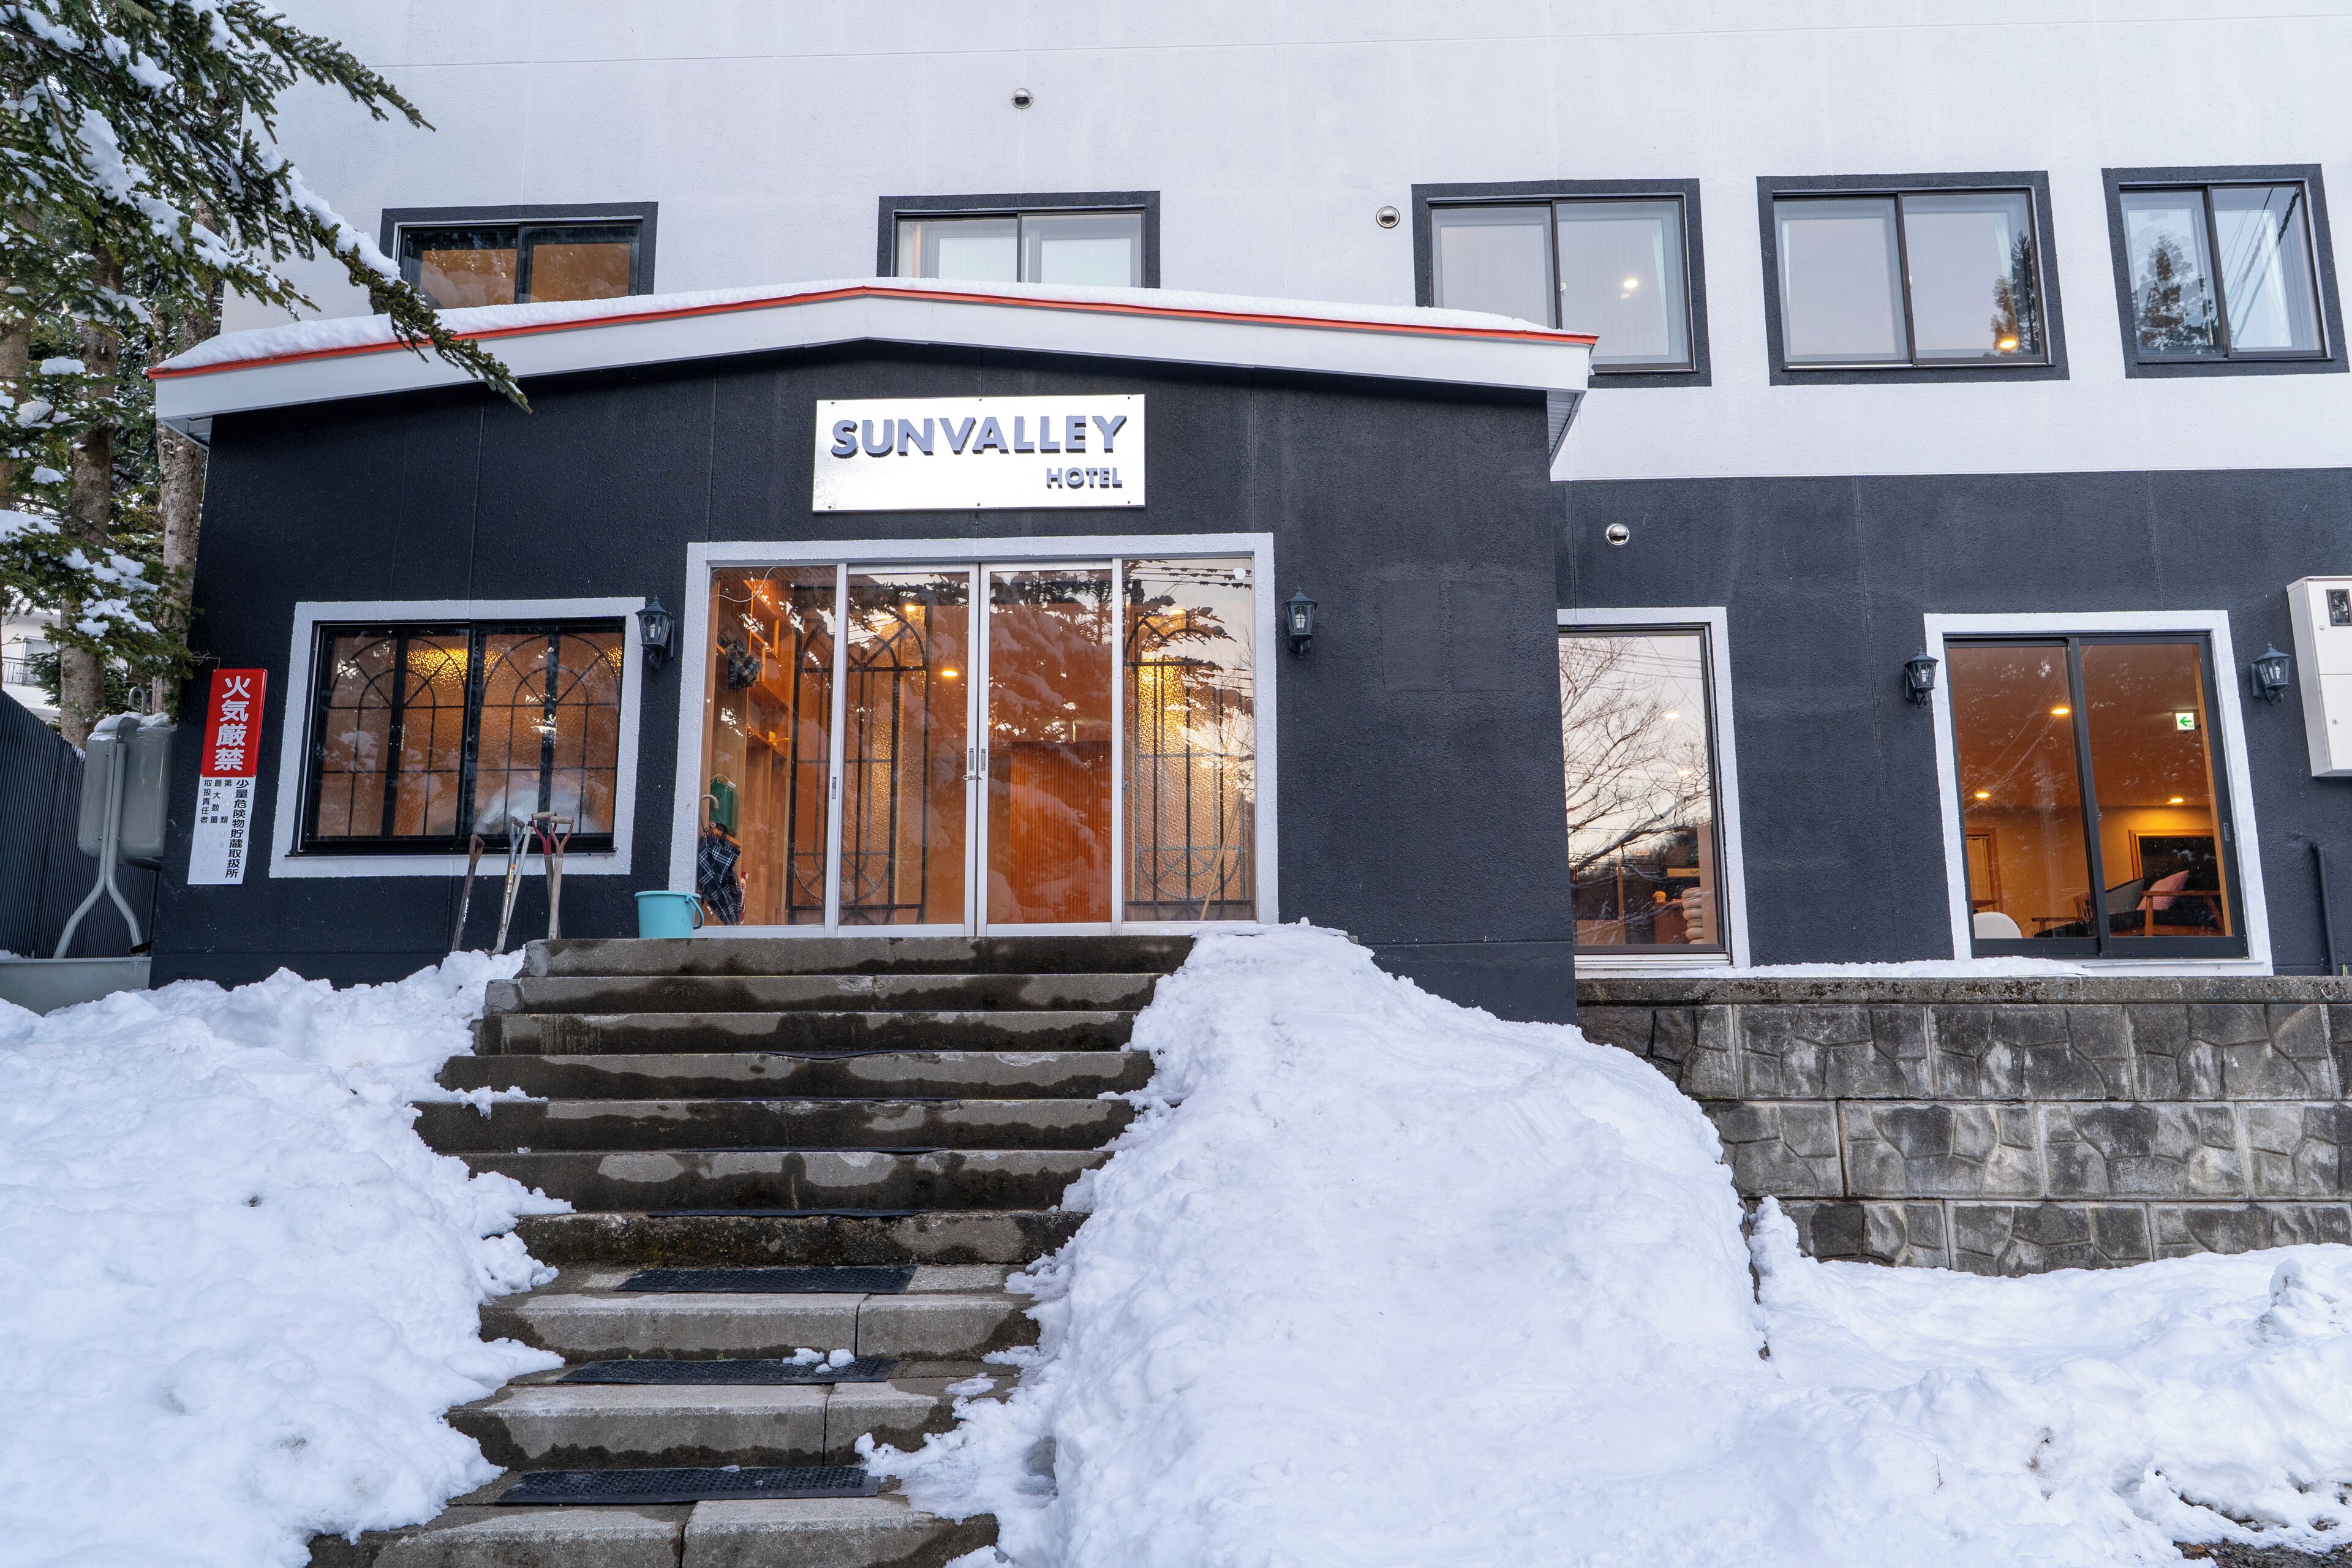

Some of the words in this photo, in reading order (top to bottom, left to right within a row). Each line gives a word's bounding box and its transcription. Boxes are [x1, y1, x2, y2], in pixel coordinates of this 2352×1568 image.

[831, 416, 1127, 458] SUNVALLEY
[1046, 467, 1122, 489] HOTEL
[214, 675, 251, 771] 火気厳禁
[200, 779, 213, 824] 取扱責任者
[225, 779, 249, 878] 少量危険物貯蔵取扱所
